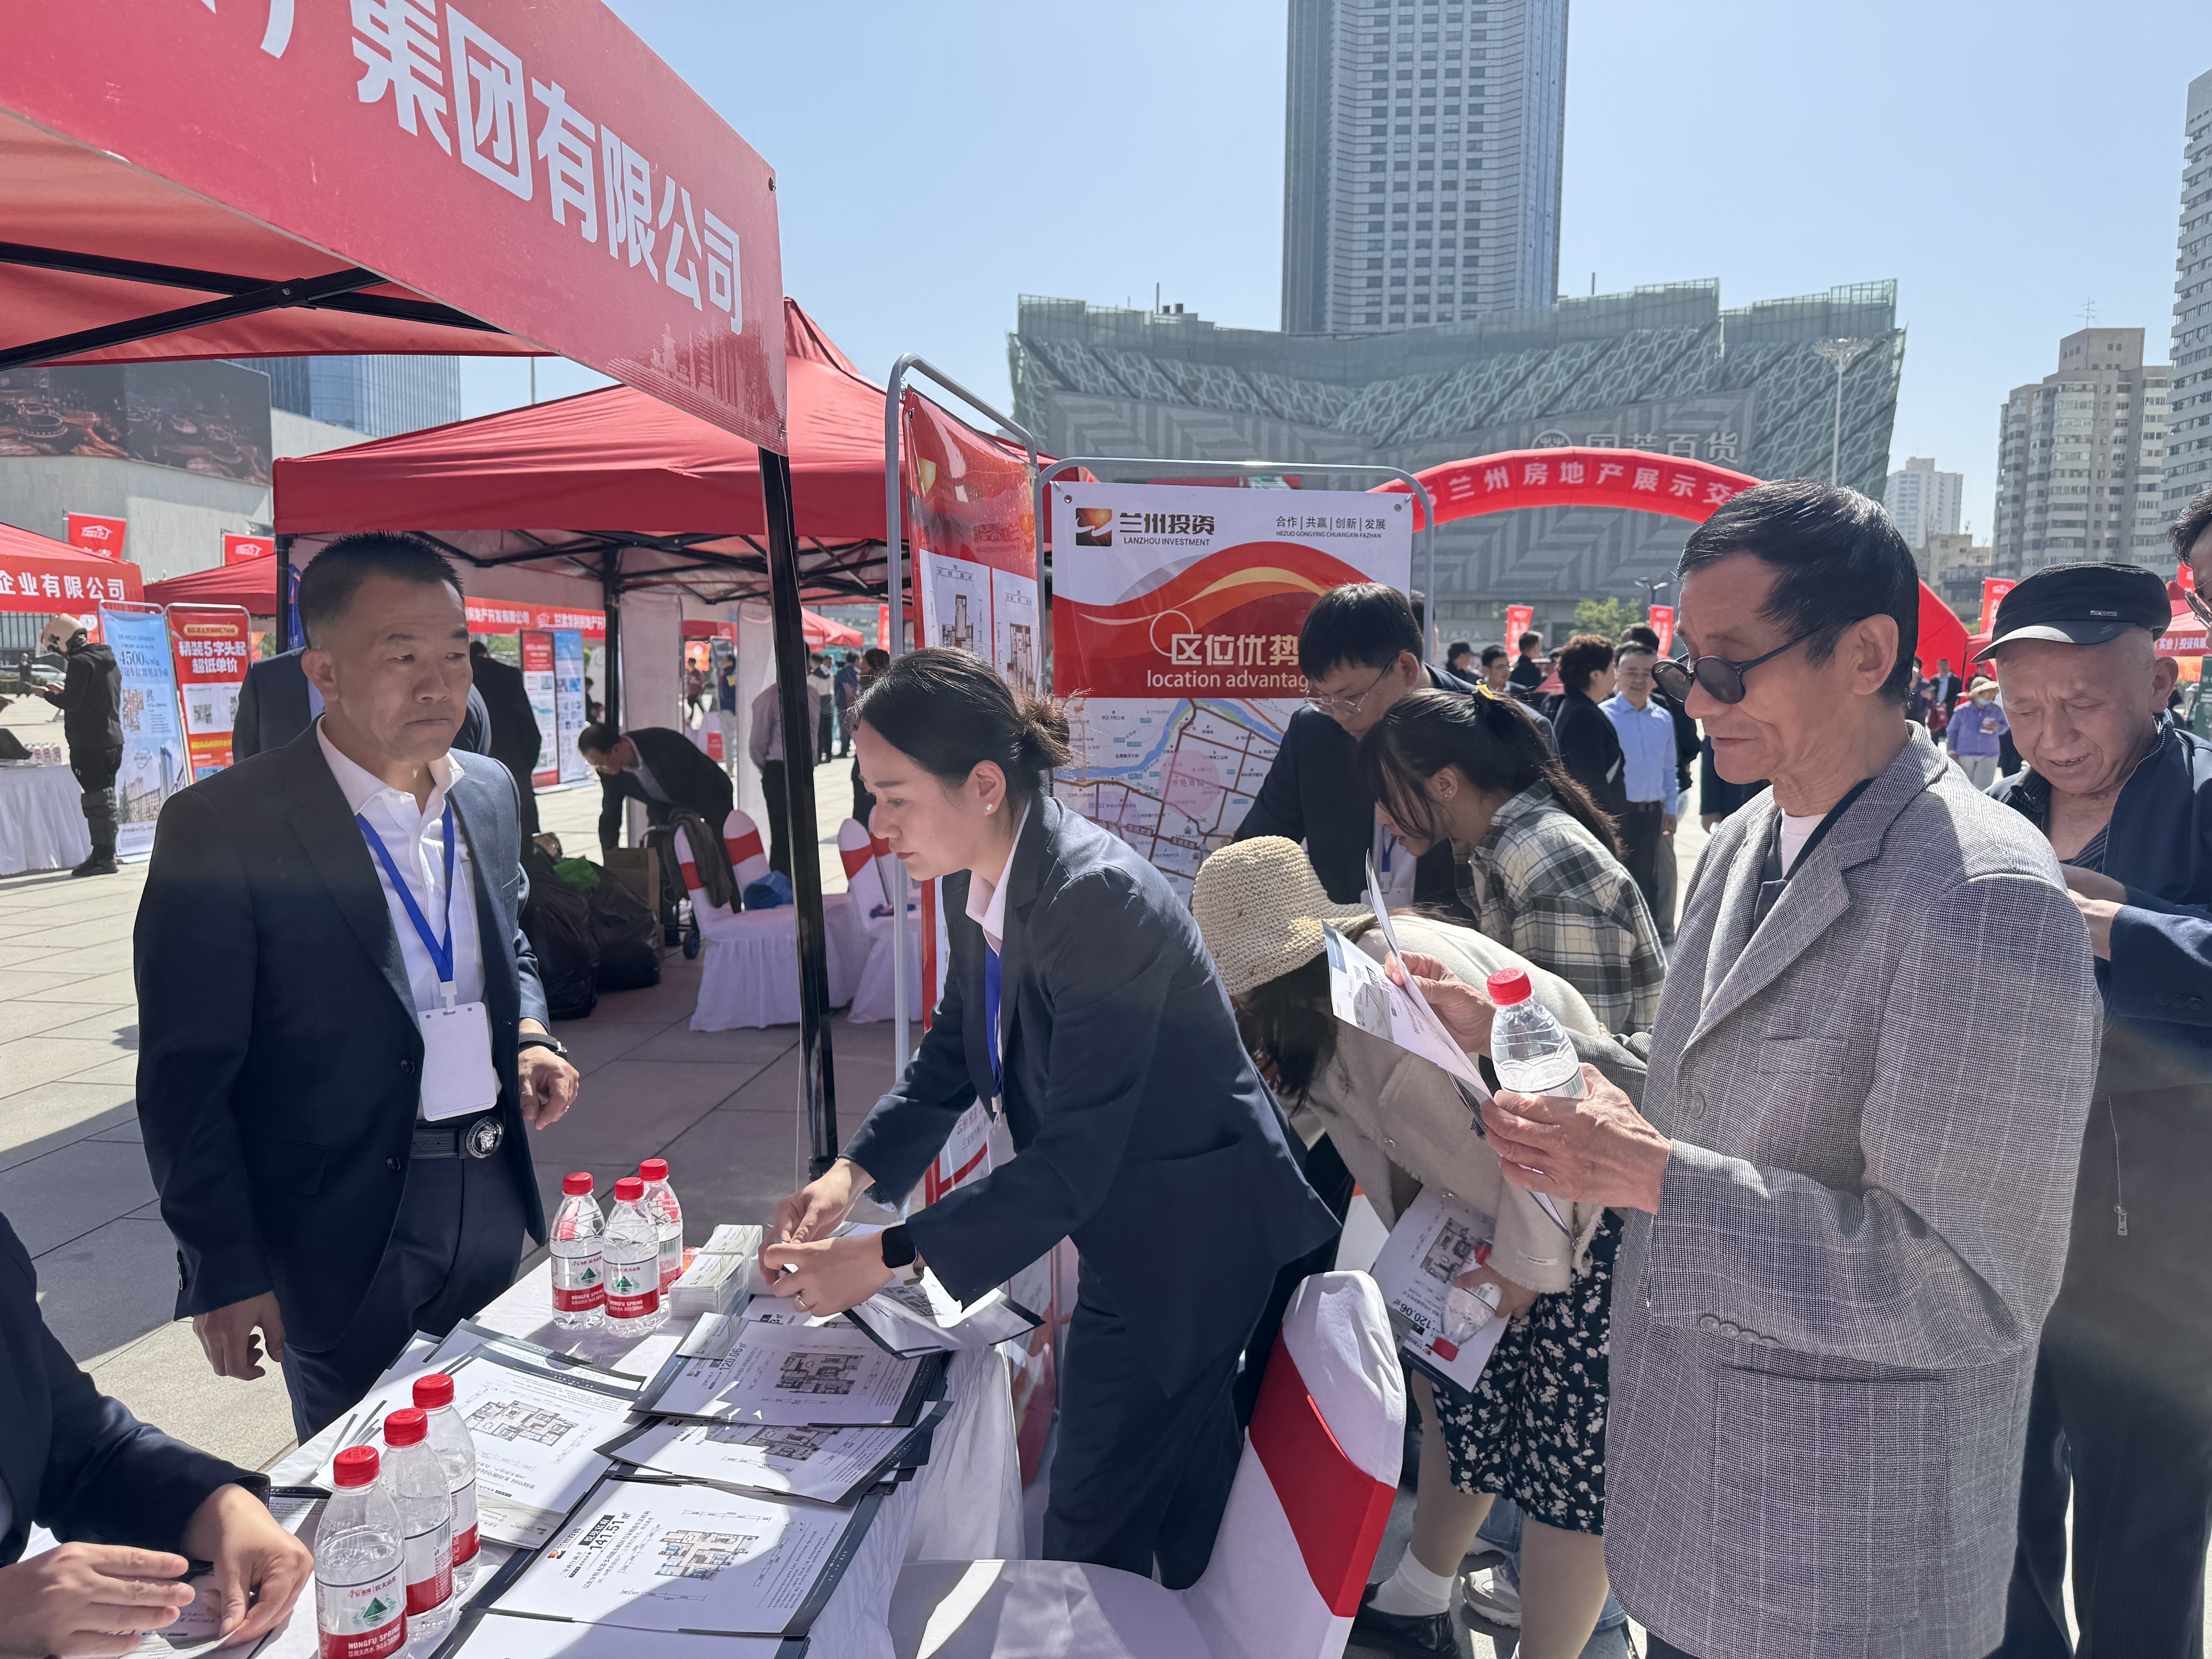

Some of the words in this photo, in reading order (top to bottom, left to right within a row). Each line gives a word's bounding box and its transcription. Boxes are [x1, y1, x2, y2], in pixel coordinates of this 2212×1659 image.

[260, 0, 742, 335] 集团有限公司
[1120, 512, 1215, 536] 兰州投资
[1276, 515, 1297, 528] 合作
[1306, 516, 1327, 529] 共赢
[1336, 517, 1357, 529] 创新
[1365, 518, 1386, 530] 发展
[1124, 536, 1160, 545] LANZHOU
[1161, 538, 1210, 546] INVESTMENT
[0, 570, 125, 601] 企业有限公司
[179, 641, 247, 657] 精装5字头起
[1171, 633, 1299, 666] 区位优势
[193, 657, 237, 673] 超低单价
[1147, 670, 1220, 688] location
[1226, 670, 1309, 693] advantag
[1400, 1302, 1432, 1329] 120.06
[720, 1348, 743, 1371] 120.06
[589, 1520, 625, 1550] 141.51
[348, 1637, 377, 1650] NONGFU
[379, 1623, 400, 1641] SPRING
